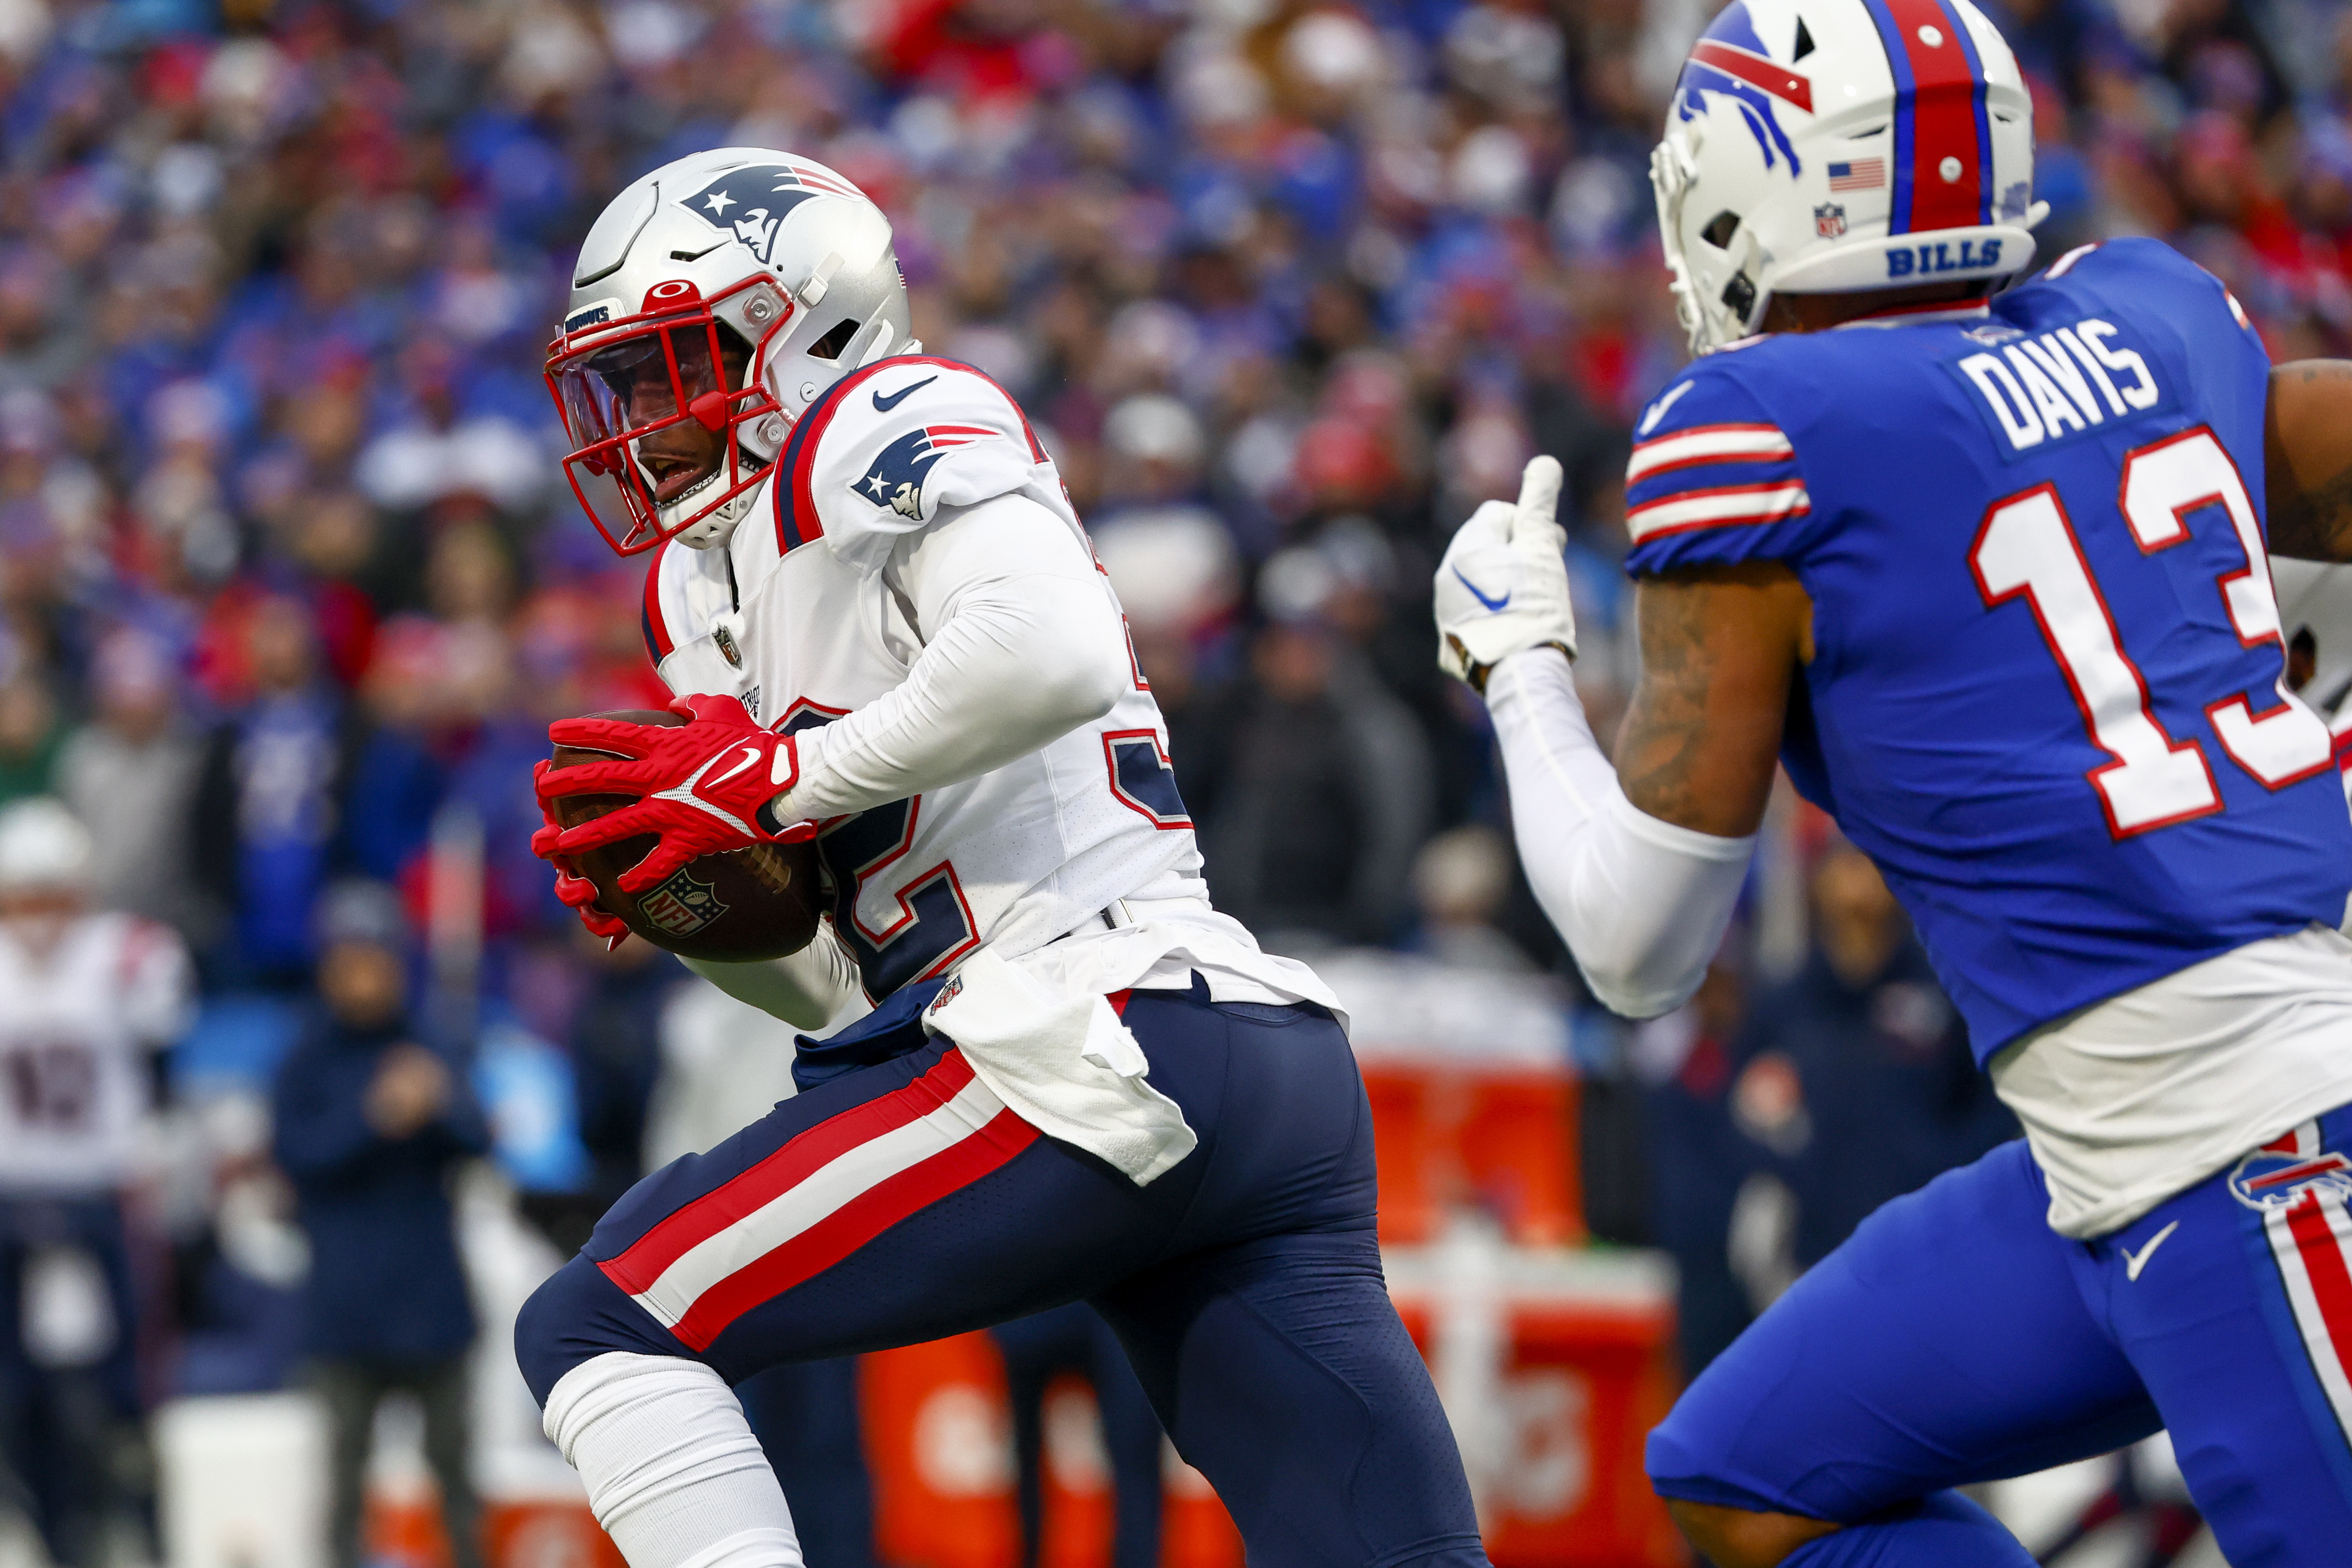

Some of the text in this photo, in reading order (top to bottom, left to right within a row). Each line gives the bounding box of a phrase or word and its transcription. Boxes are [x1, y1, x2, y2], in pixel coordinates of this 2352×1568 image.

[1886, 238, 2003, 278] BILLS
[1957, 318, 2159, 451] DAVIS
[1966, 422, 2337, 842] 13
[644, 892, 697, 934] NFL
[933, 987, 961, 1011] NFL
